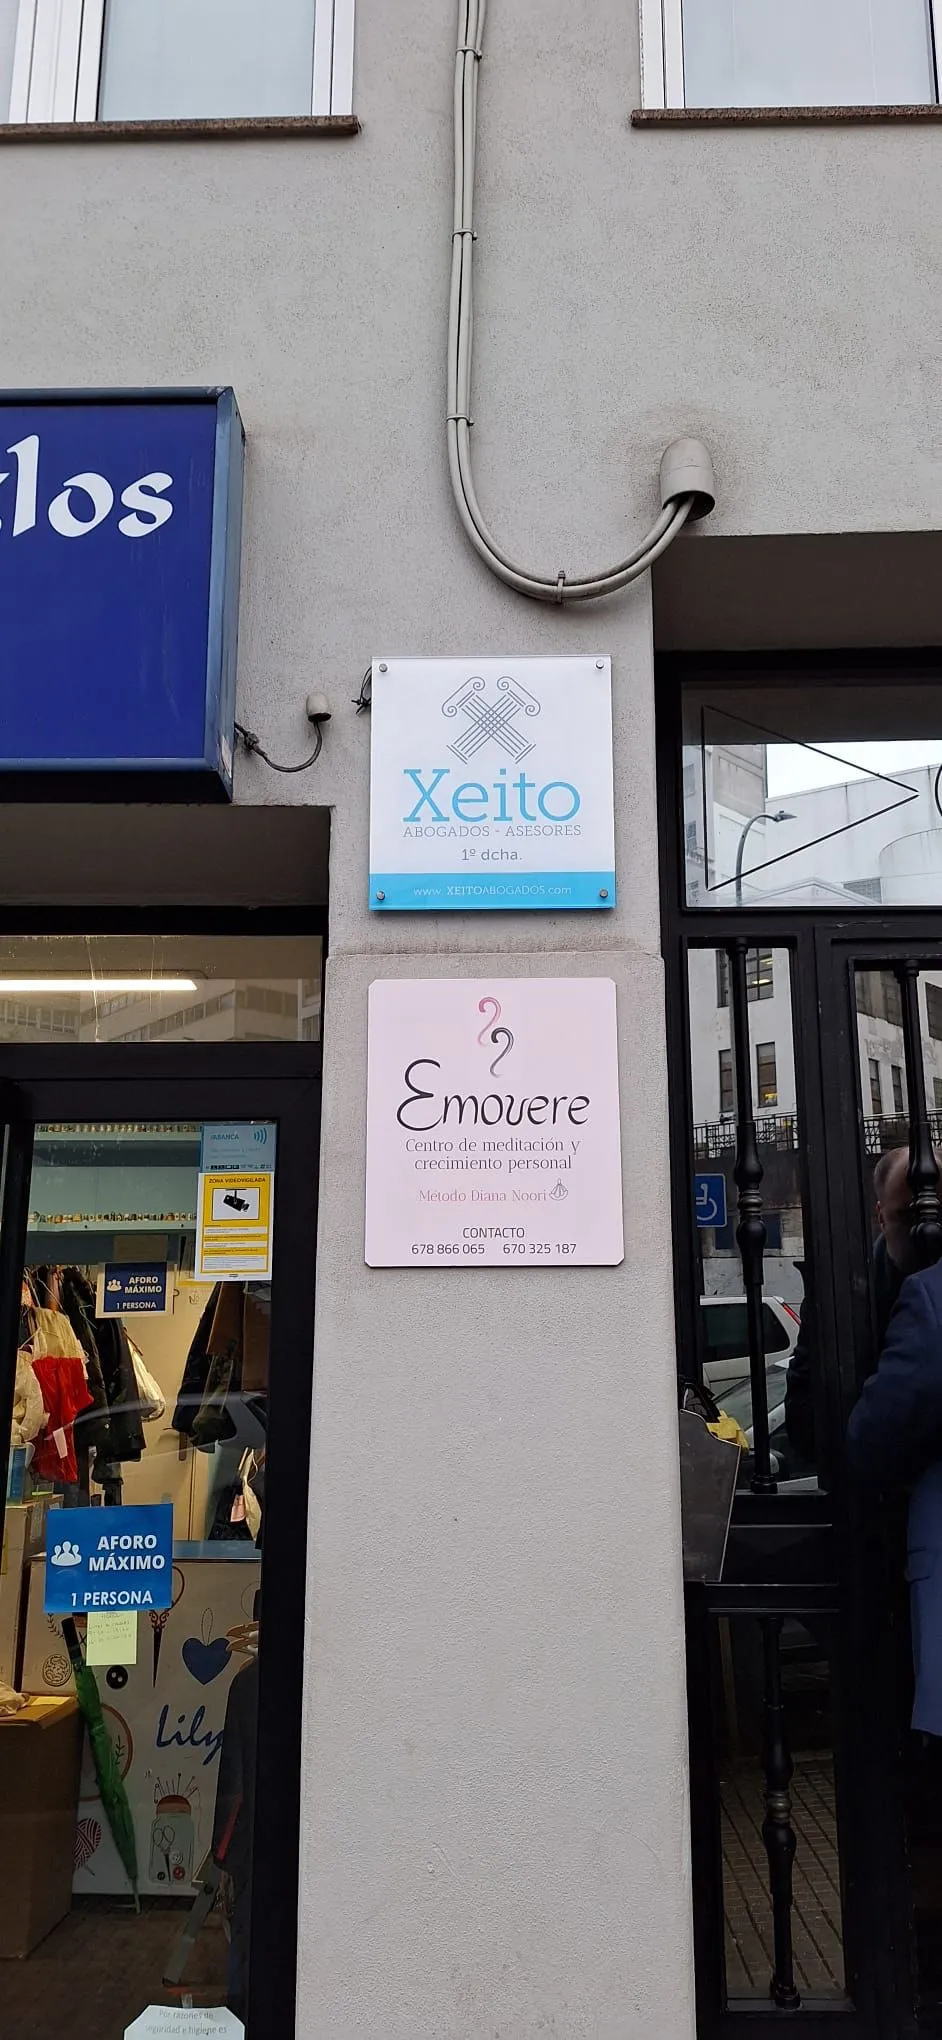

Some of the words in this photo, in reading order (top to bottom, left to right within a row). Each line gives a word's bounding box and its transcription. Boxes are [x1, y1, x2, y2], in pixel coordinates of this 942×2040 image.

[0, 434, 174, 538] los
[402, 768, 581, 823] Xeito
[402, 825, 490, 838] ABOGADOS
[505, 825, 582, 837] ASESORES
[480, 848, 523, 861] dcha.
[396, 1058, 591, 1132] Emovere
[405, 1138, 454, 1152] Centro
[458, 1138, 477, 1151] de
[482, 1137, 564, 1151] meditación
[570, 1139, 581, 1155] y
[414, 1156, 503, 1171] crecimiento
[507, 1155, 572, 1173] personal
[418, 1187, 467, 1202] Método
[471, 1188, 507, 1201] Diana
[511, 1188, 547, 1201] Noori
[463, 1227, 525, 1239] CONTACTO
[411, 1244, 435, 1255] 678
[437, 1244, 460, 1255] 866
[462, 1244, 485, 1255] 065
[503, 1243, 527, 1255] 670
[529, 1243, 552, 1255] 325
[555, 1243, 577, 1254] 187
[128, 1276, 159, 1284] AFORO
[124, 1284, 162, 1294] MÁXIMO
[97, 1535, 157, 1550] AFORO
[89, 1553, 165, 1571] MÁXIMO
[71, 1593, 77, 1606] 1
[83, 1591, 153, 1606] PERSONA
